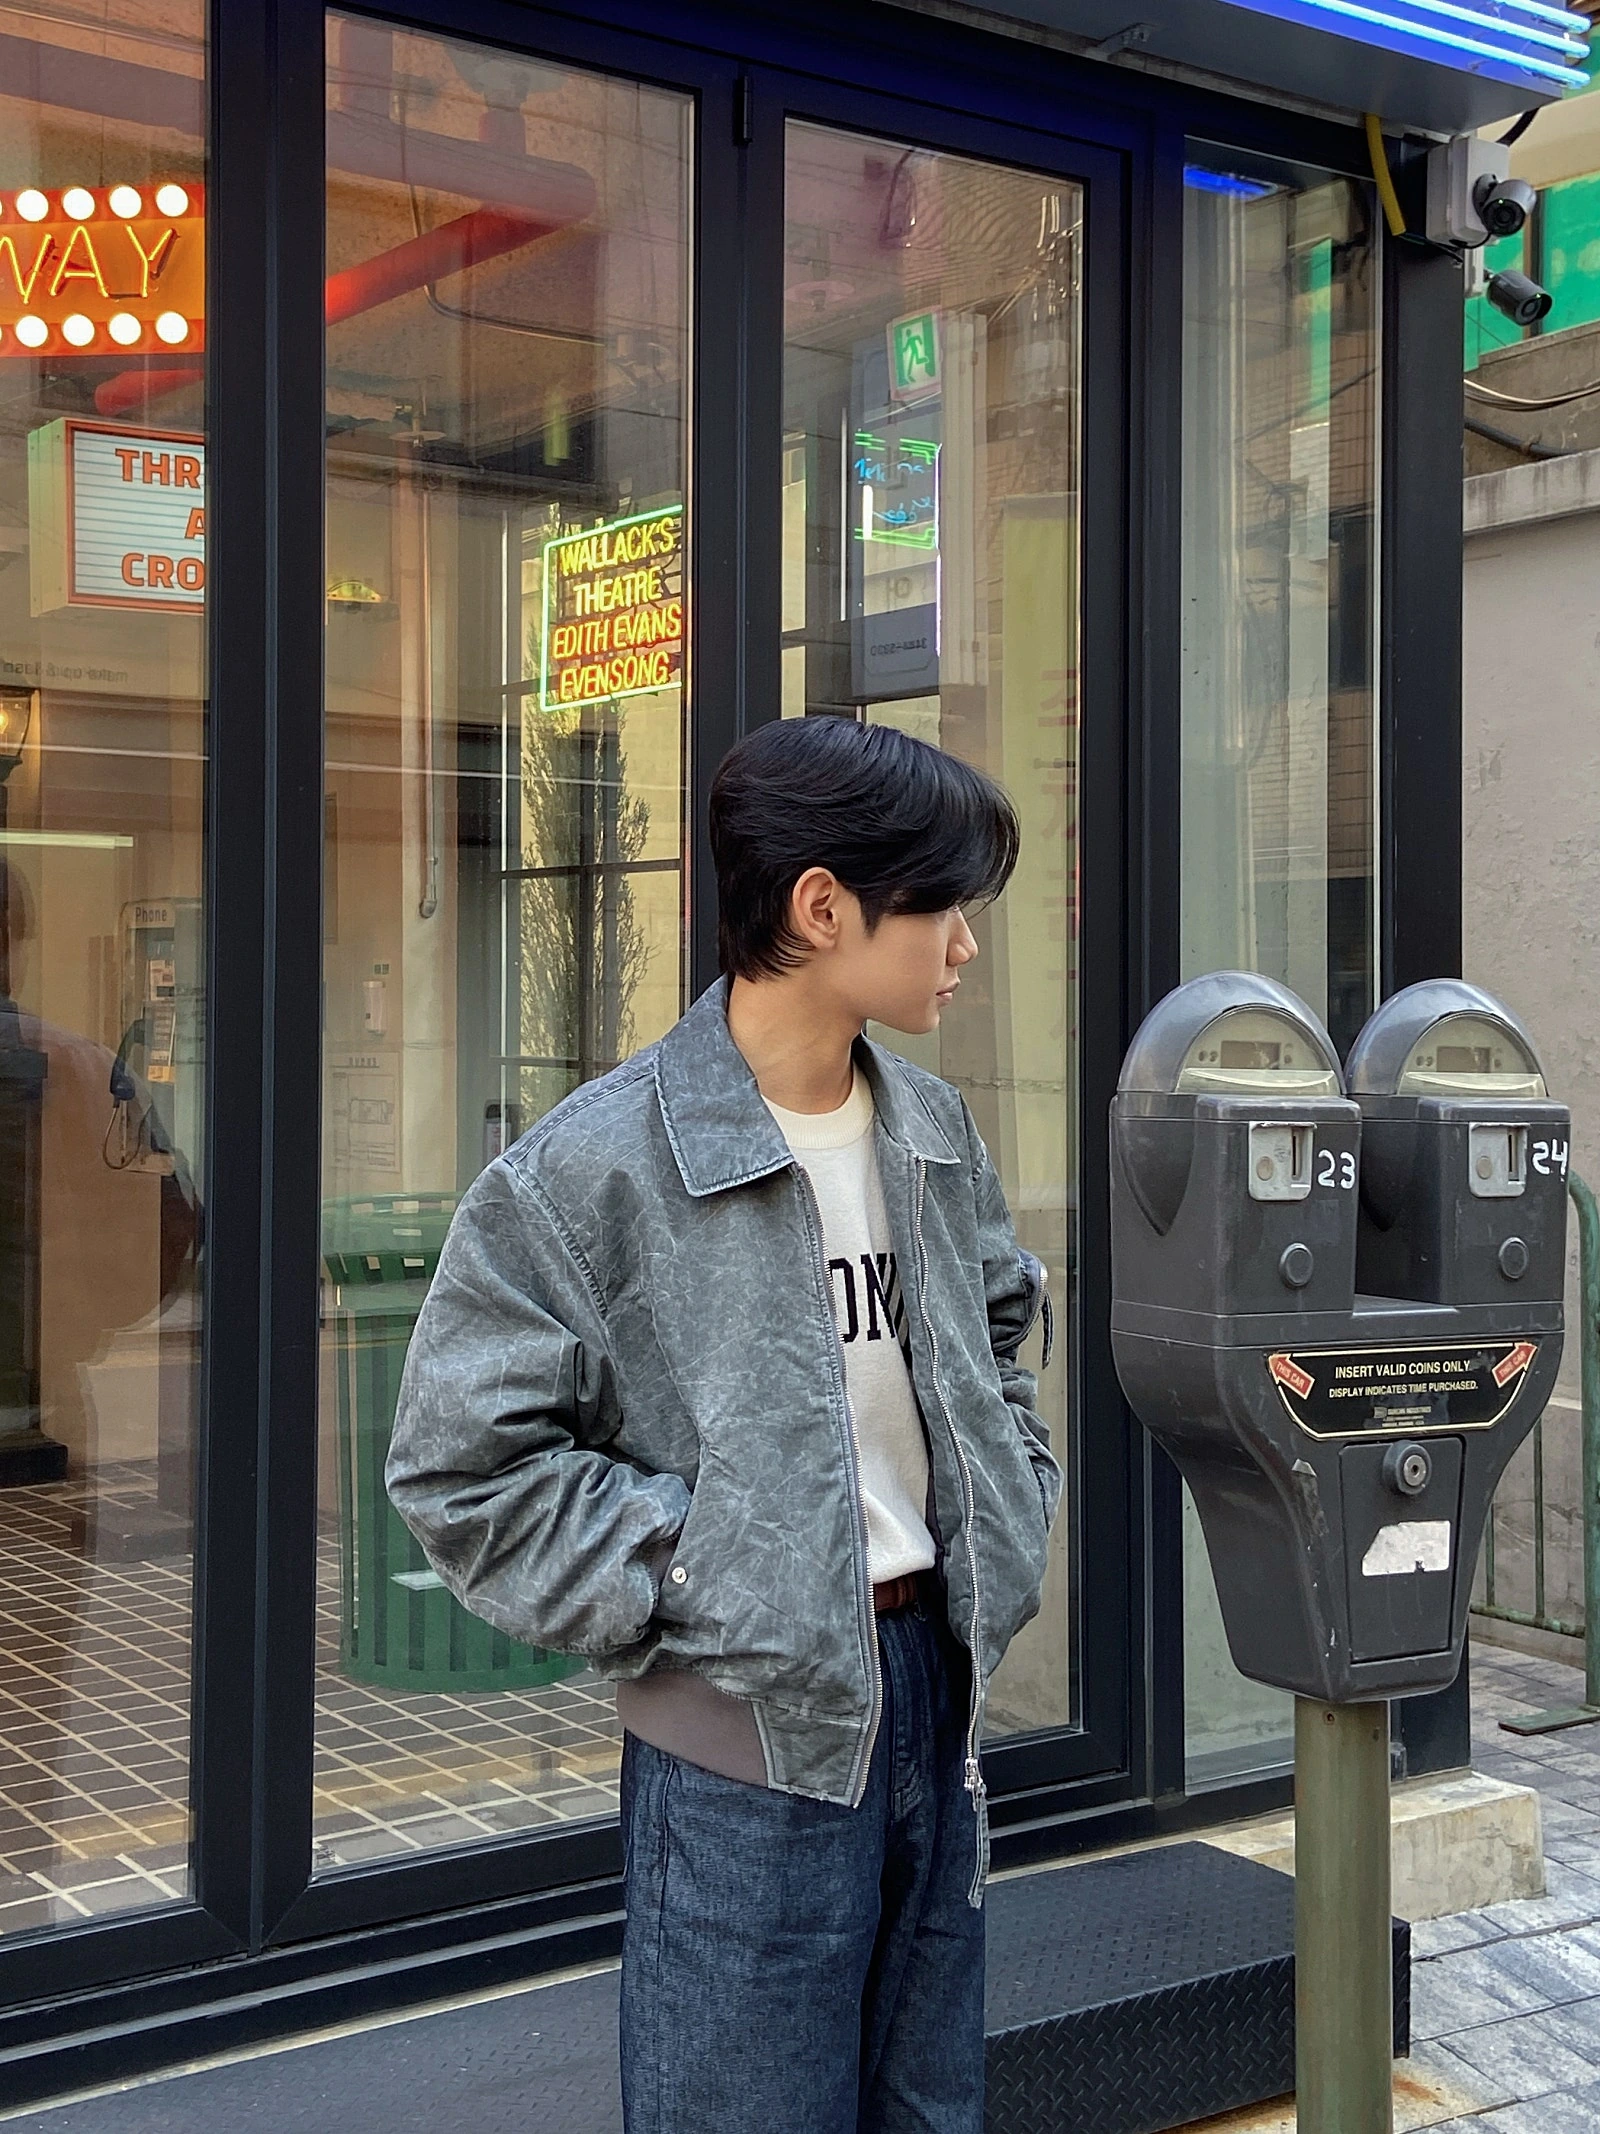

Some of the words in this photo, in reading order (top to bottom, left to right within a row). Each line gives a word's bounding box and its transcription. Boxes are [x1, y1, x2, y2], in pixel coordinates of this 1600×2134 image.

[115, 448, 201, 489] THR
[560, 517, 675, 576] WALLACK'S
[121, 552, 205, 591] CRO
[573, 566, 662, 616] THEATRE
[554, 618, 610, 659] EDITH
[613, 603, 682, 648] EVANS
[559, 651, 670, 700] EVENSONG
[135, 906, 167, 922] Phone
[1317, 1149, 1356, 1189] 23
[1532, 1138, 1568, 1176] 24
[1335, 1365, 1374, 1379] INSERT
[1376, 1363, 1407, 1377] VALID
[1408, 1361, 1441, 1375] COINS
[1329, 1387, 1363, 1398] DISPLAY
[1365, 1384, 1407, 1396] INDICATES
[1408, 1383, 1428, 1394] TIME
